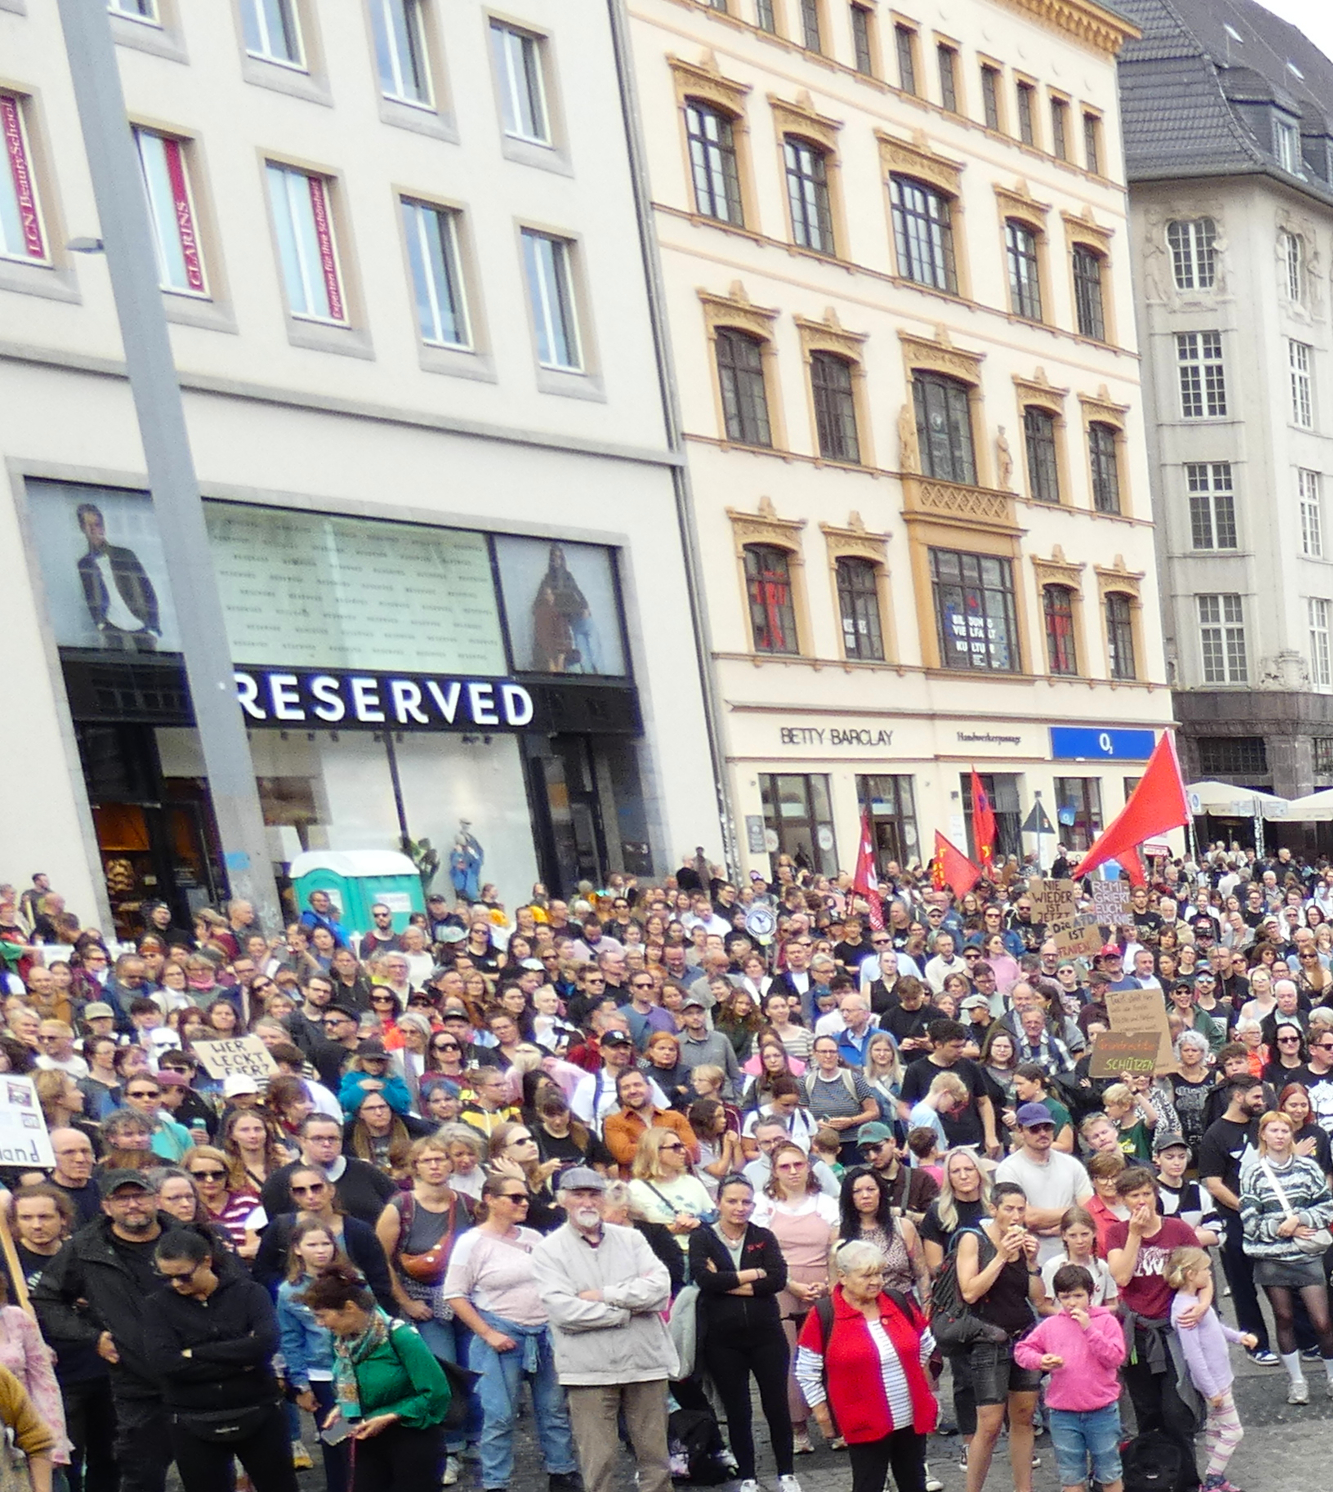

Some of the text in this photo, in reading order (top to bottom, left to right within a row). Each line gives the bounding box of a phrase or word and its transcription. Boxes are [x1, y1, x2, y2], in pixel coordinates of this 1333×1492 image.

[176, 201, 201, 286] CLARINS
[234, 672, 534, 727] RESERVED
[781, 727, 893, 746] BETTY BARCLAY
[1043, 880, 1061, 891] NIE
[1032, 891, 1073, 903] WIEDER
[1095, 903, 1123, 914] EUCH
[1068, 927, 1085, 941] IST
[210, 1040, 247, 1053] WER
[211, 1052, 264, 1067] LECKT
